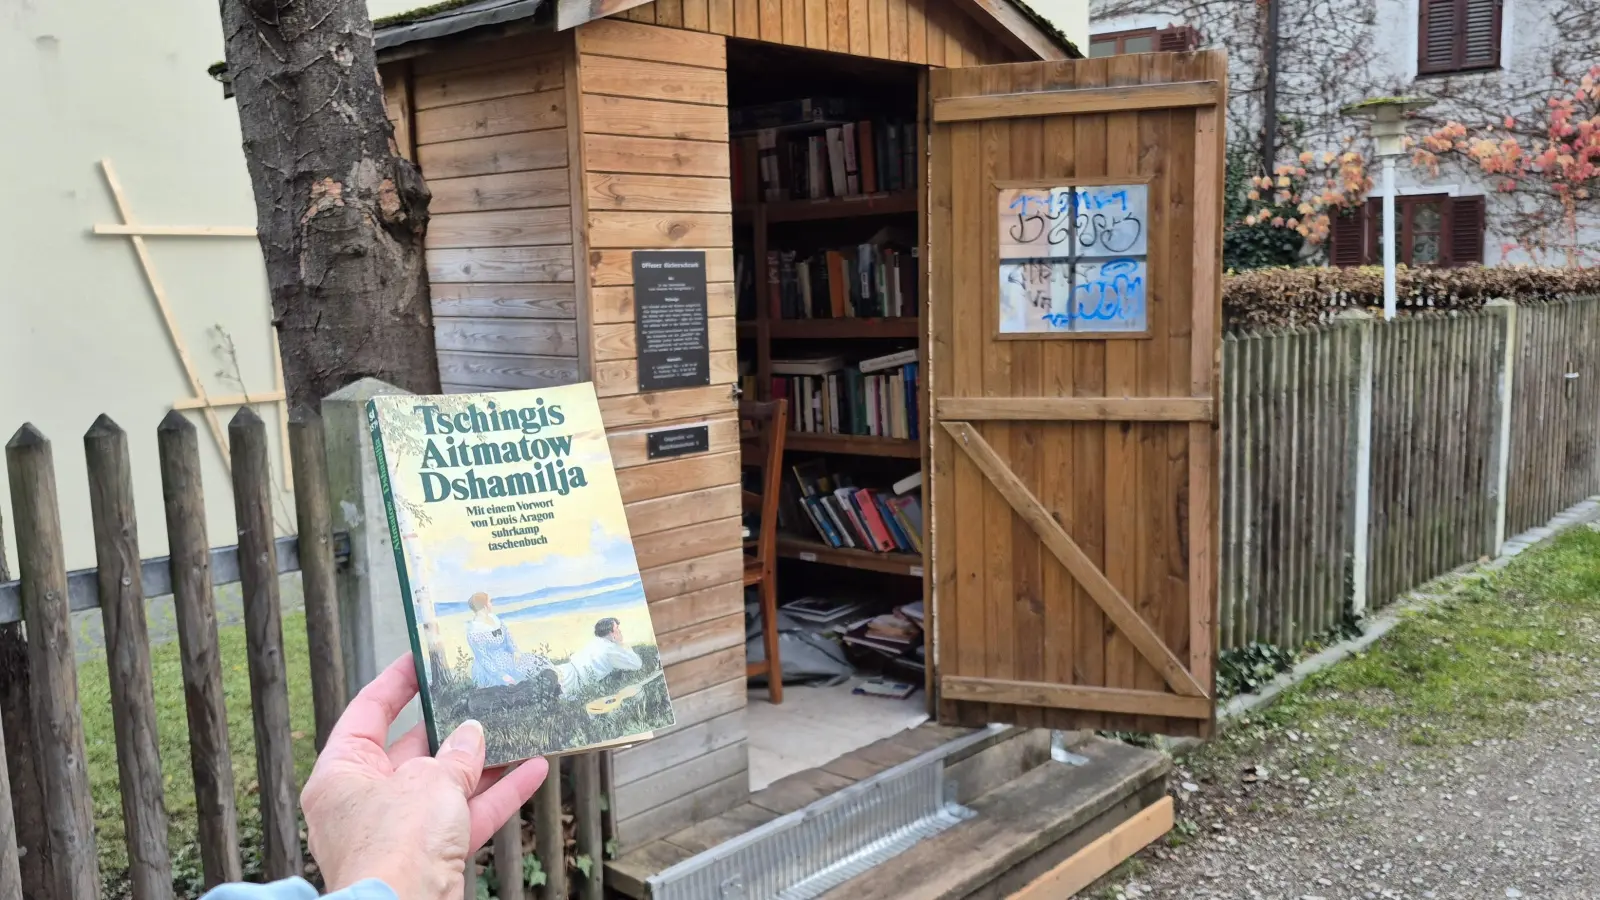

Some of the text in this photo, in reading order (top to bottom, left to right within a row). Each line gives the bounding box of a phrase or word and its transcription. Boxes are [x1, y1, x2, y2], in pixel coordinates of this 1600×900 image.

[413, 397, 565, 435] Tschingis
[420, 435, 573, 469] Aitmatow
[418, 459, 588, 503] Dshamilja
[466, 498, 554, 516] Mit einem Vorwort
[470, 511, 555, 528] von Louis Aragon
[491, 525, 540, 539] suhrkamp
[488, 534, 548, 552] taschenbuch
